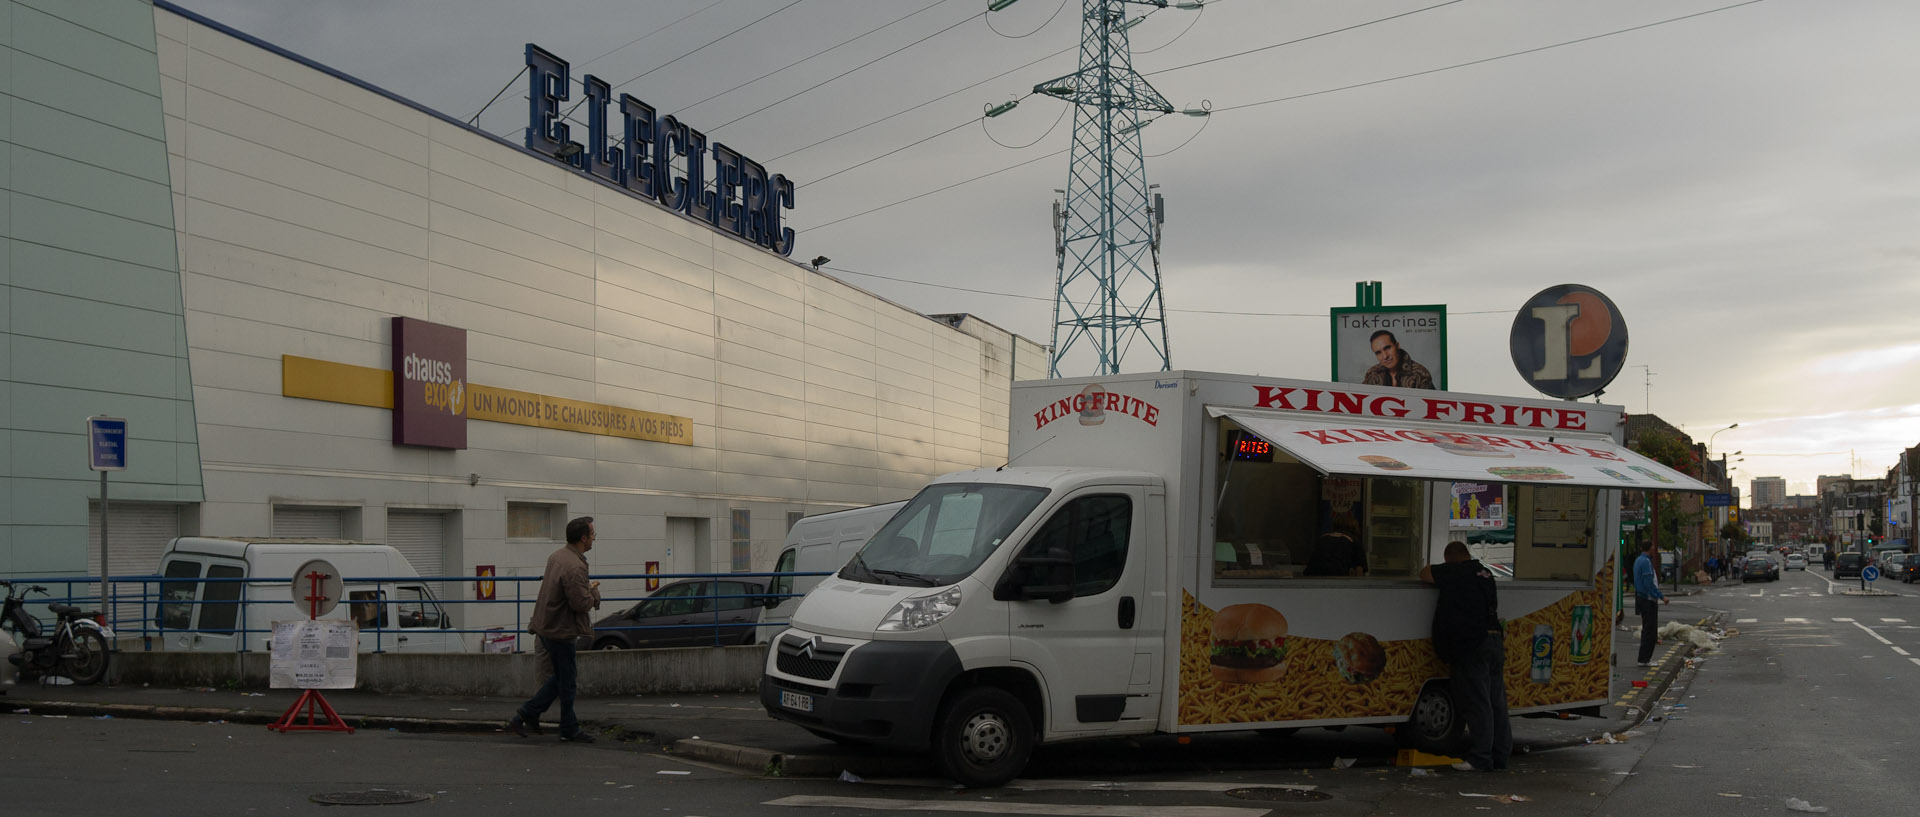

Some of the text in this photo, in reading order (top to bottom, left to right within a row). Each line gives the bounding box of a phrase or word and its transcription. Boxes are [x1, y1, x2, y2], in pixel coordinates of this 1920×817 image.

[1341, 314, 1438, 329] Takfarinas
[404, 352, 452, 385] chauss
[473, 392, 684, 438] UN MONDE DE CHAUSSURES A VOS PIEDS
[1034, 391, 1160, 430] KING FRITE
[1252, 385, 1586, 431] KING FRITE
[1234, 439, 1270, 455] RITES
[1292, 429, 1628, 463] KING FRITE
